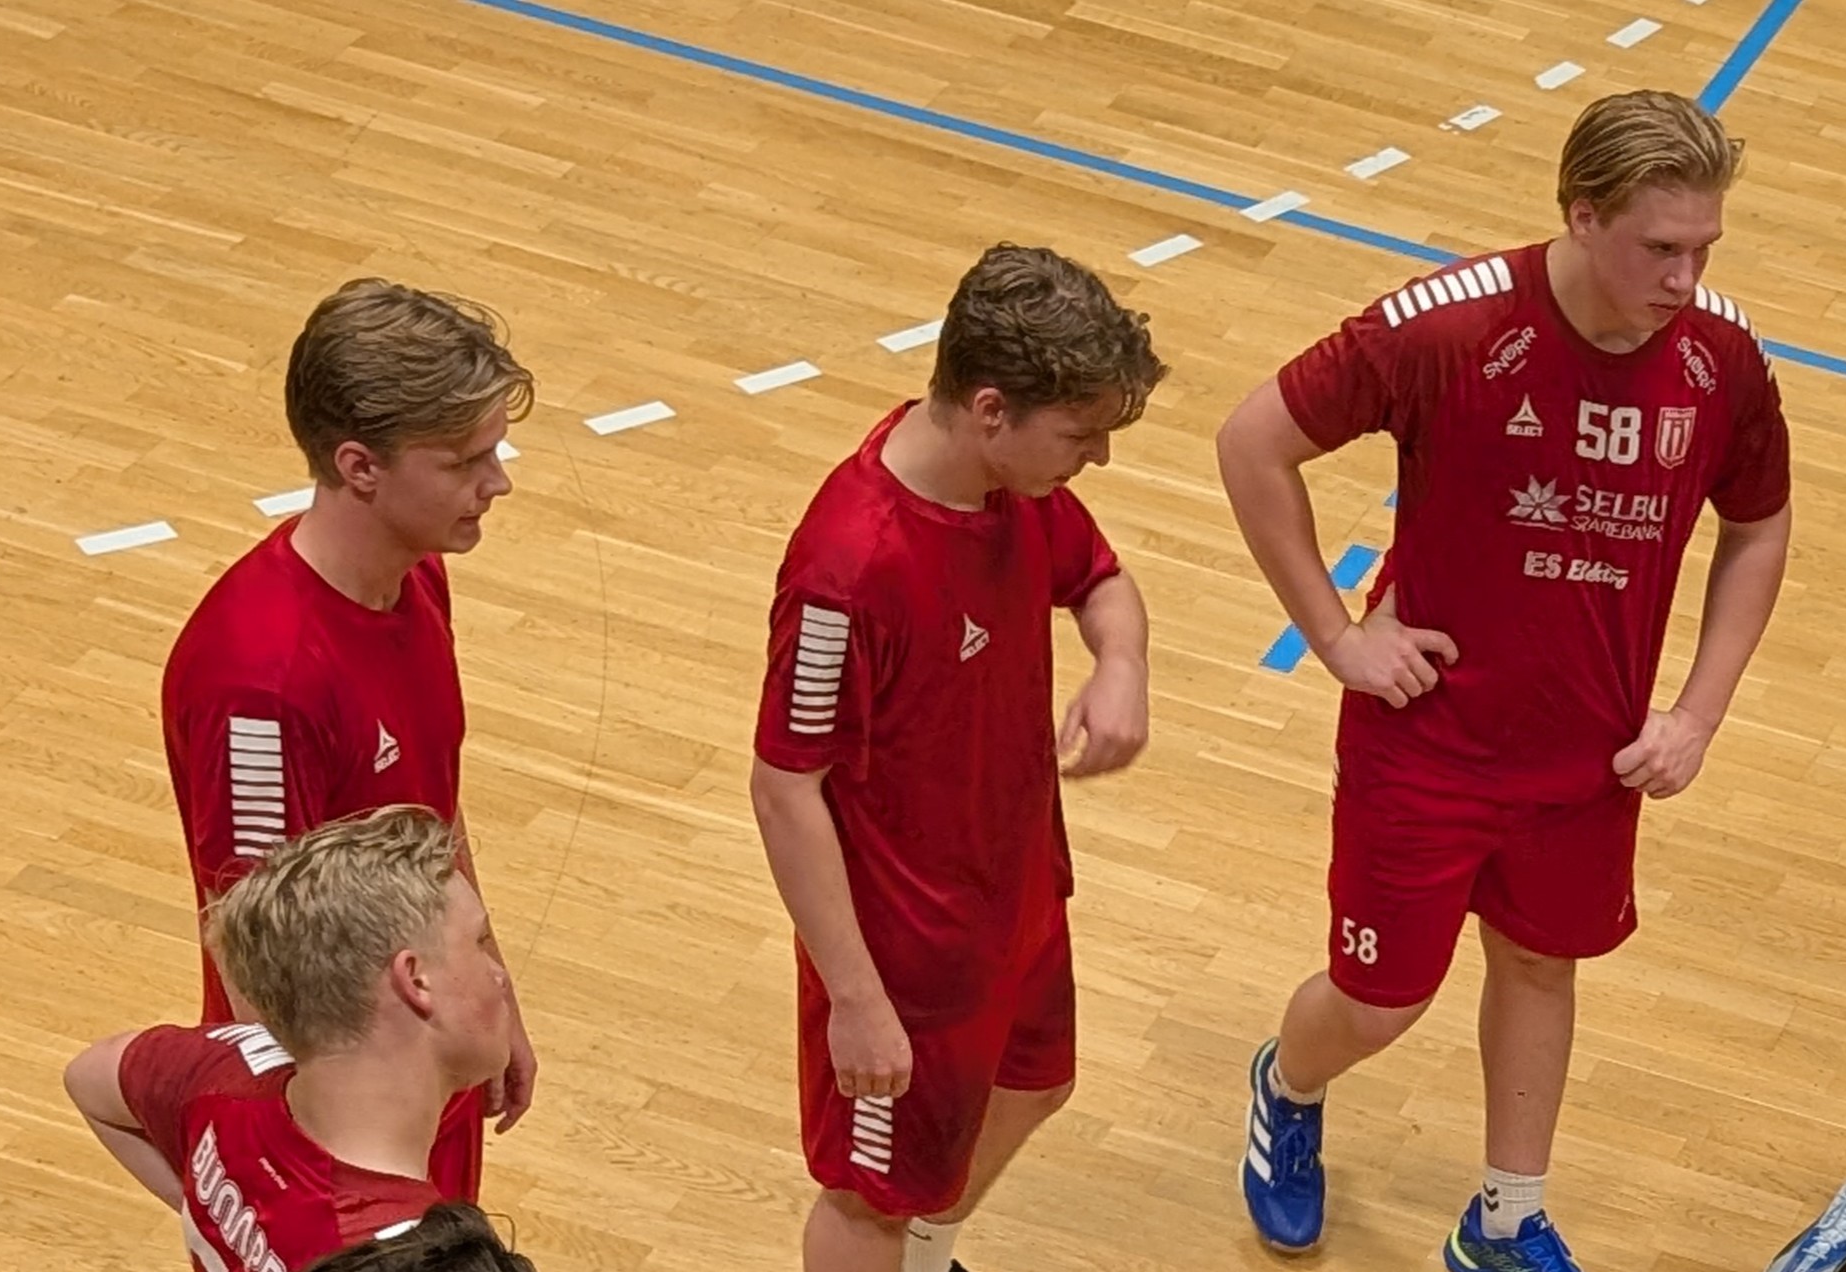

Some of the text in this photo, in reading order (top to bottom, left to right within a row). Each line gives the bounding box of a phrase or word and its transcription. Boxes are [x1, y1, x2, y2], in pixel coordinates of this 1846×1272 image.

[1575, 399, 1643, 465] 58
[1575, 485, 1669, 522] SELBU
[1523, 551, 1563, 579] ES
[1341, 916, 1378, 965] 58
